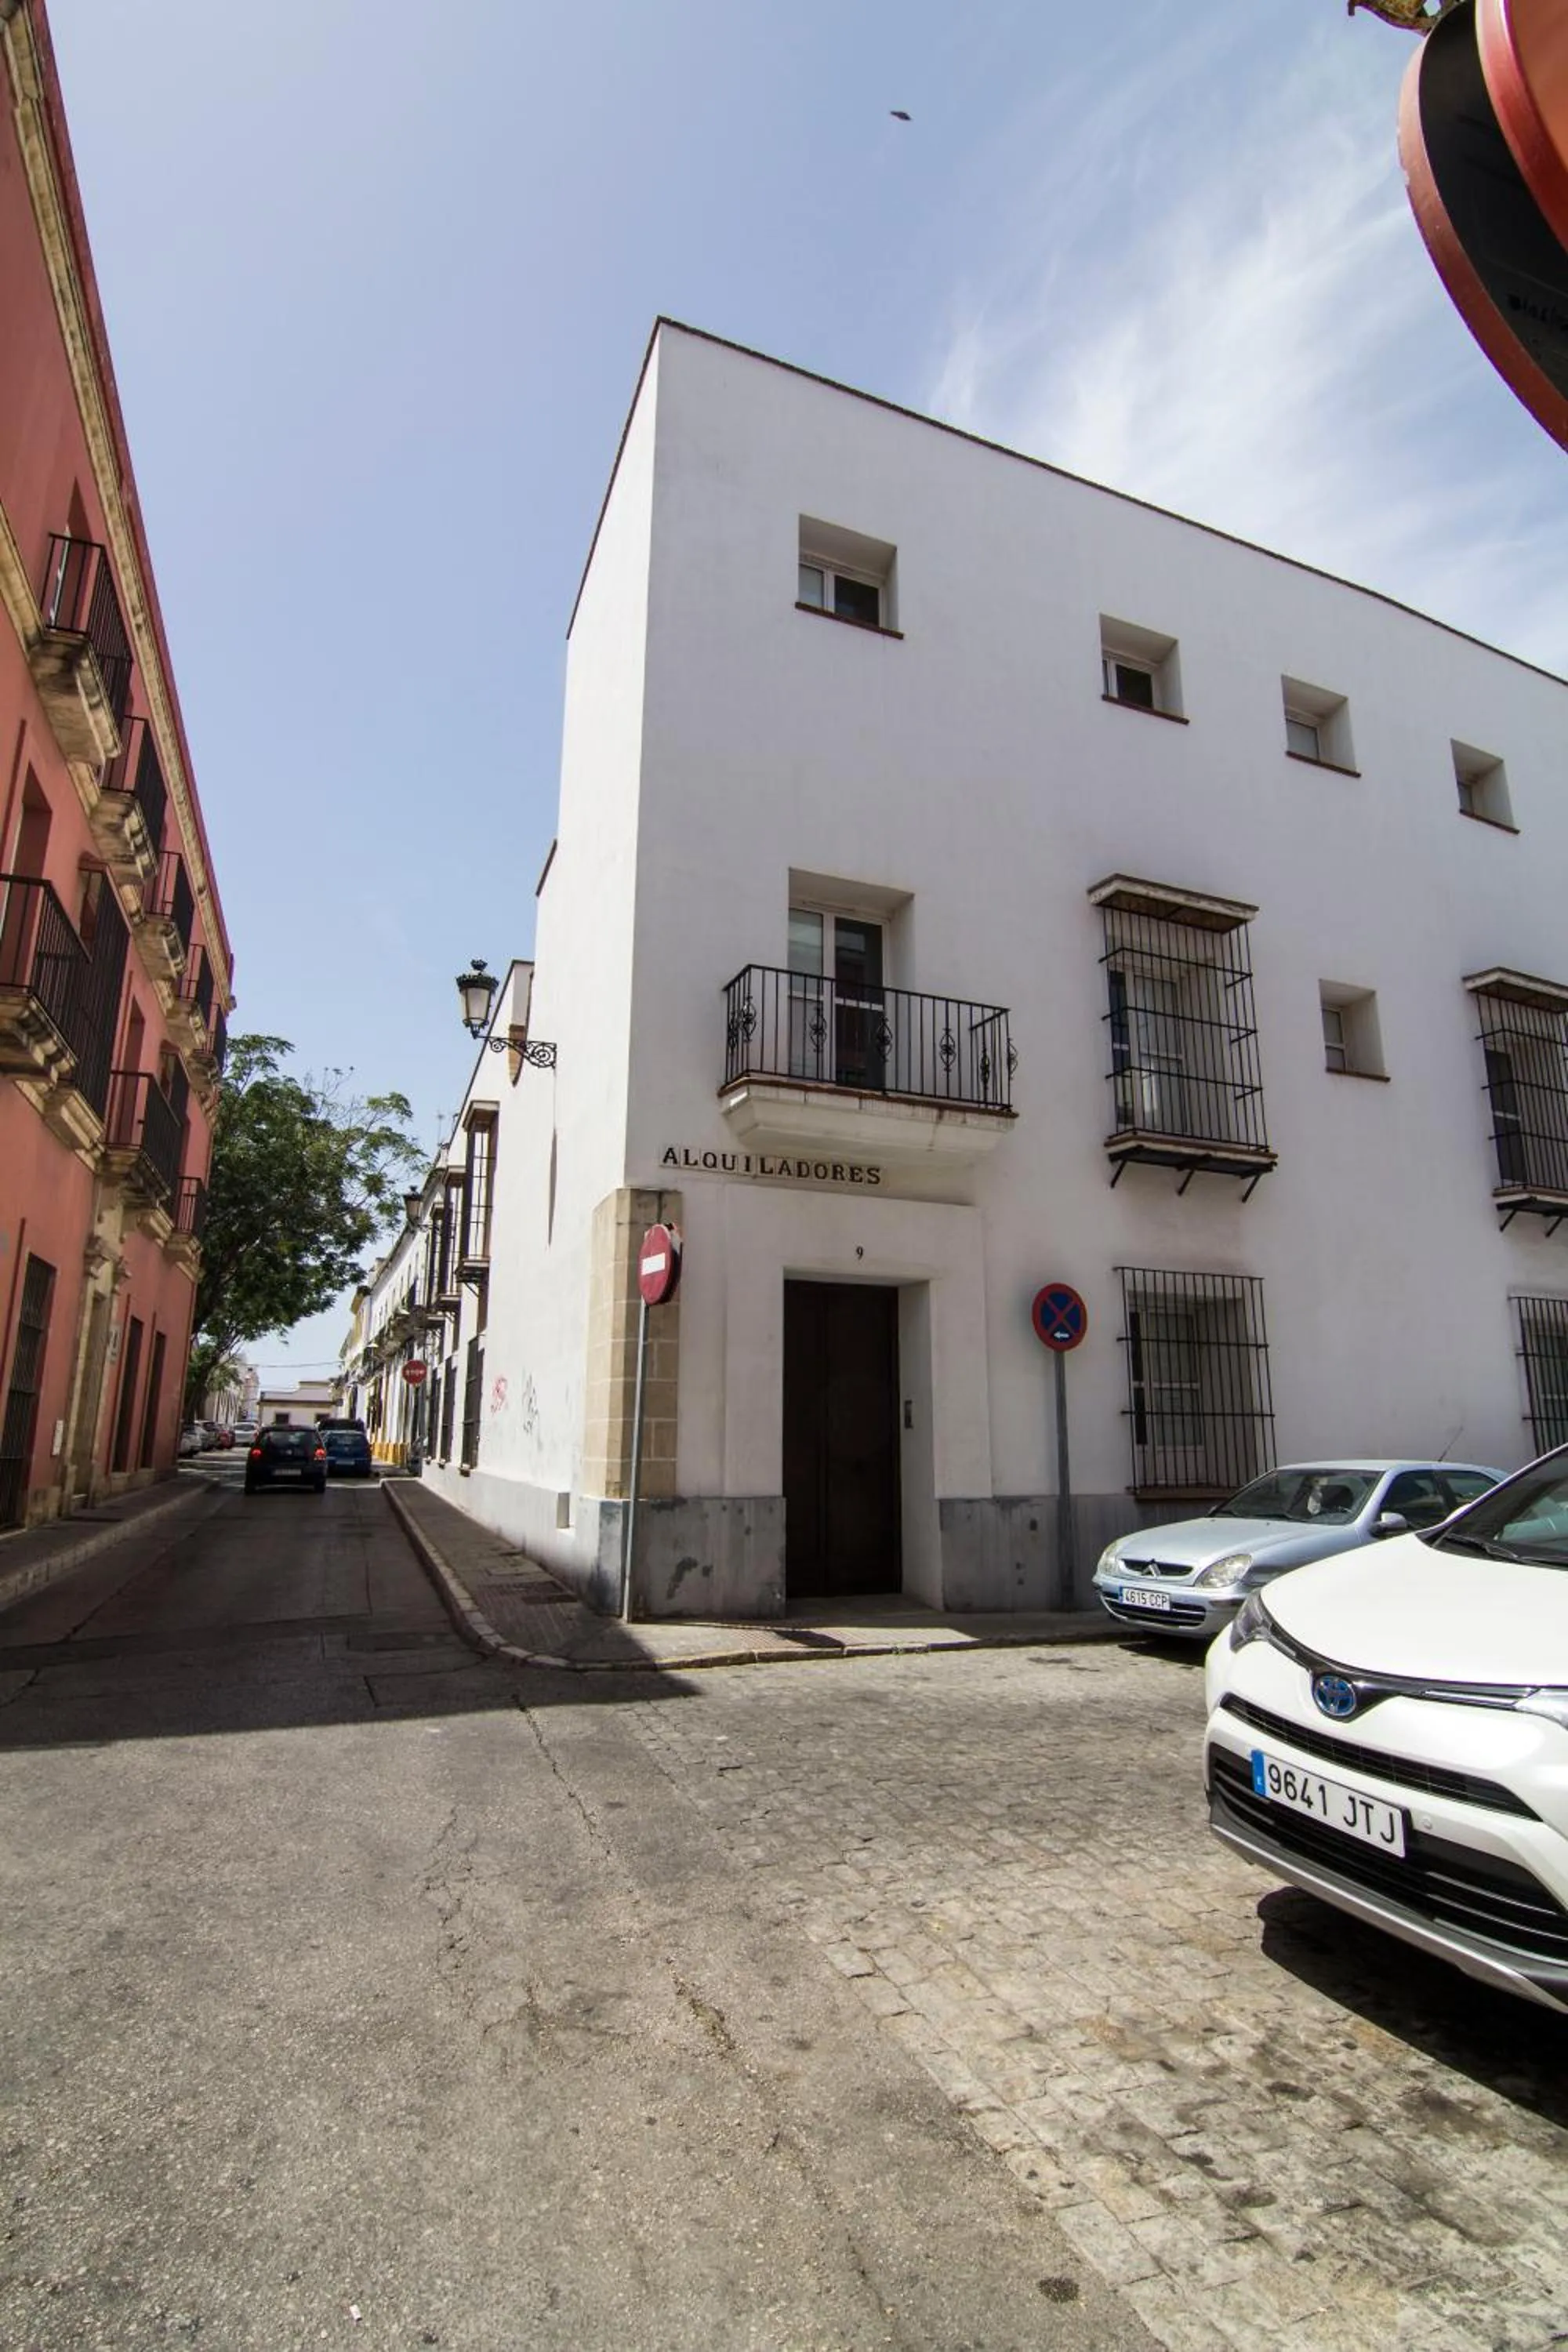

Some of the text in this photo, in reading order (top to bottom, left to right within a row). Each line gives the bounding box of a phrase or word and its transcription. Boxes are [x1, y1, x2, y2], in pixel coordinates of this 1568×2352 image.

[662, 1147, 881, 1185] ALQUILADORES
[855, 1246, 864, 1260] 9
[1268, 1764, 1395, 1843] 9641 JTJ
